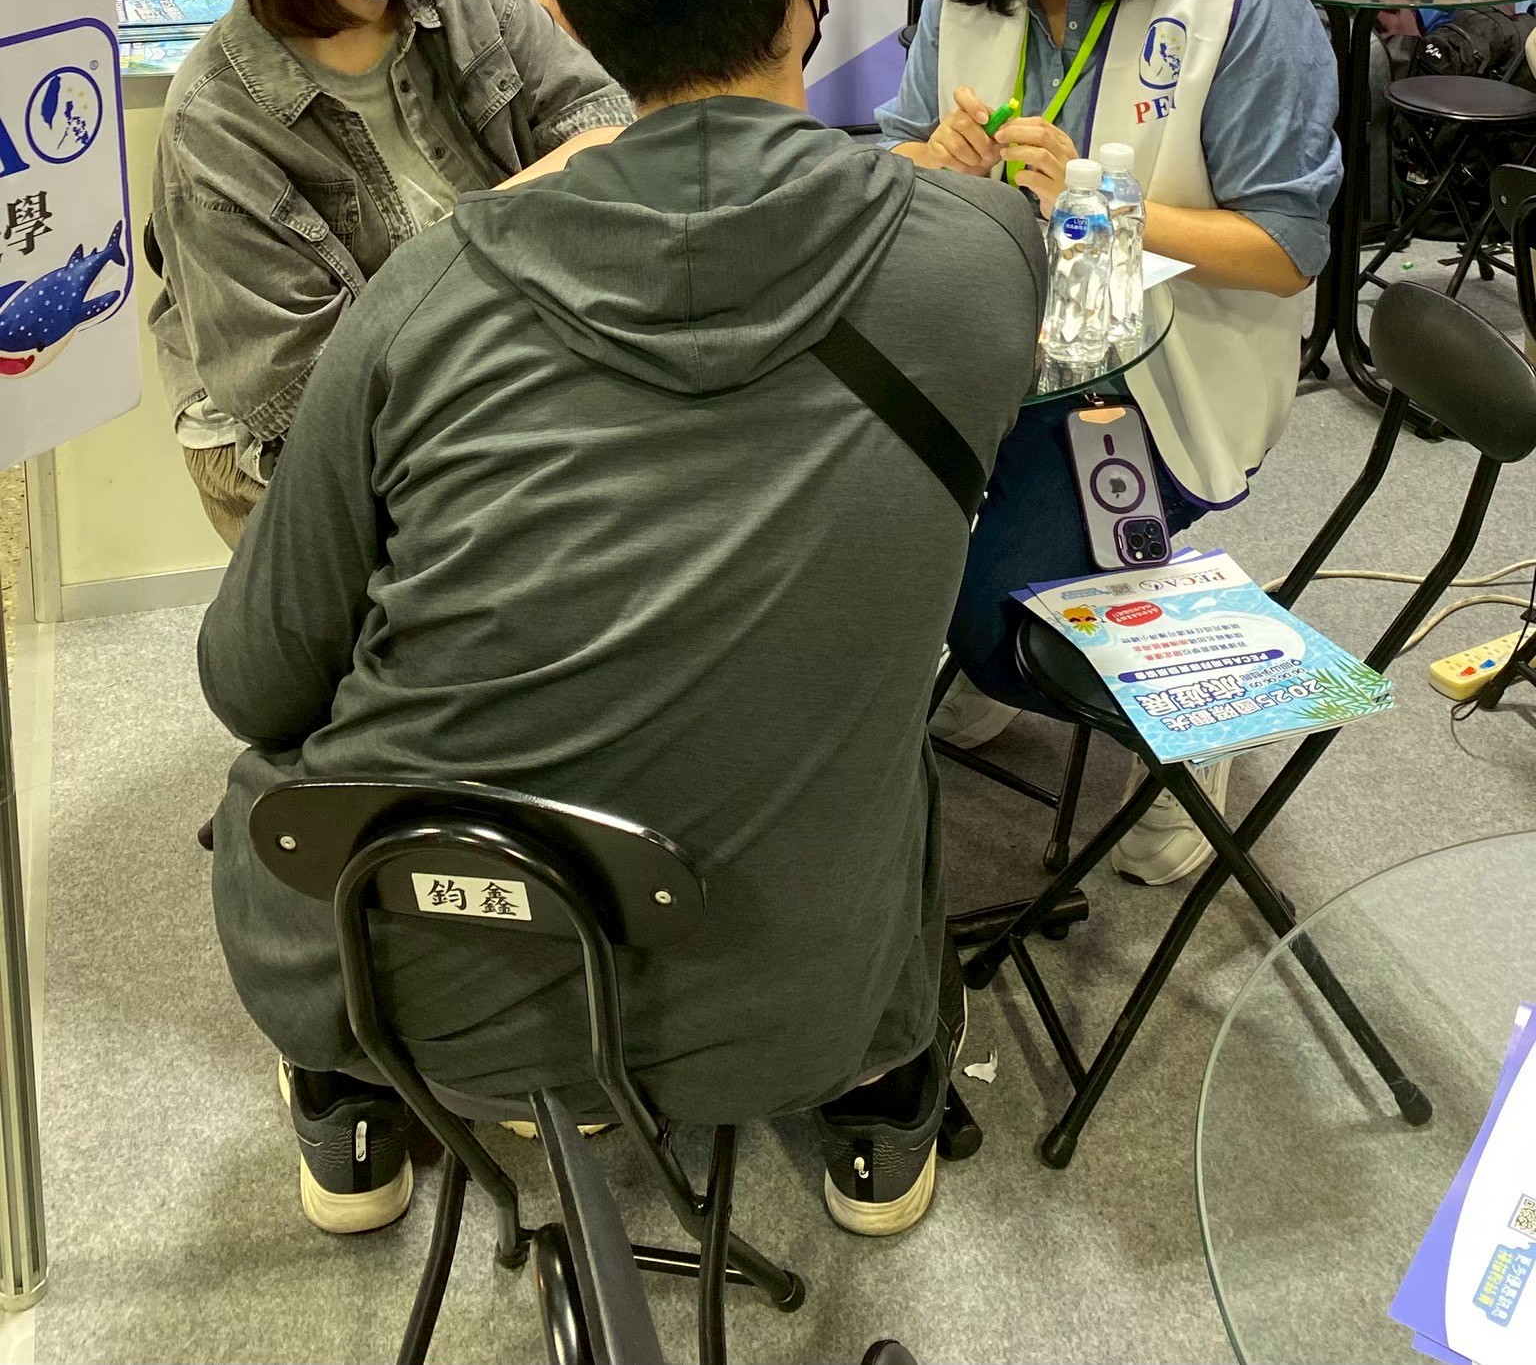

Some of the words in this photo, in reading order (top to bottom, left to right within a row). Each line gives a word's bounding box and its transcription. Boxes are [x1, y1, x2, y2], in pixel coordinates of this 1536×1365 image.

[1134, 675, 1245, 717] 旅遊展
[428, 879, 520, 916] 鈞鑫
